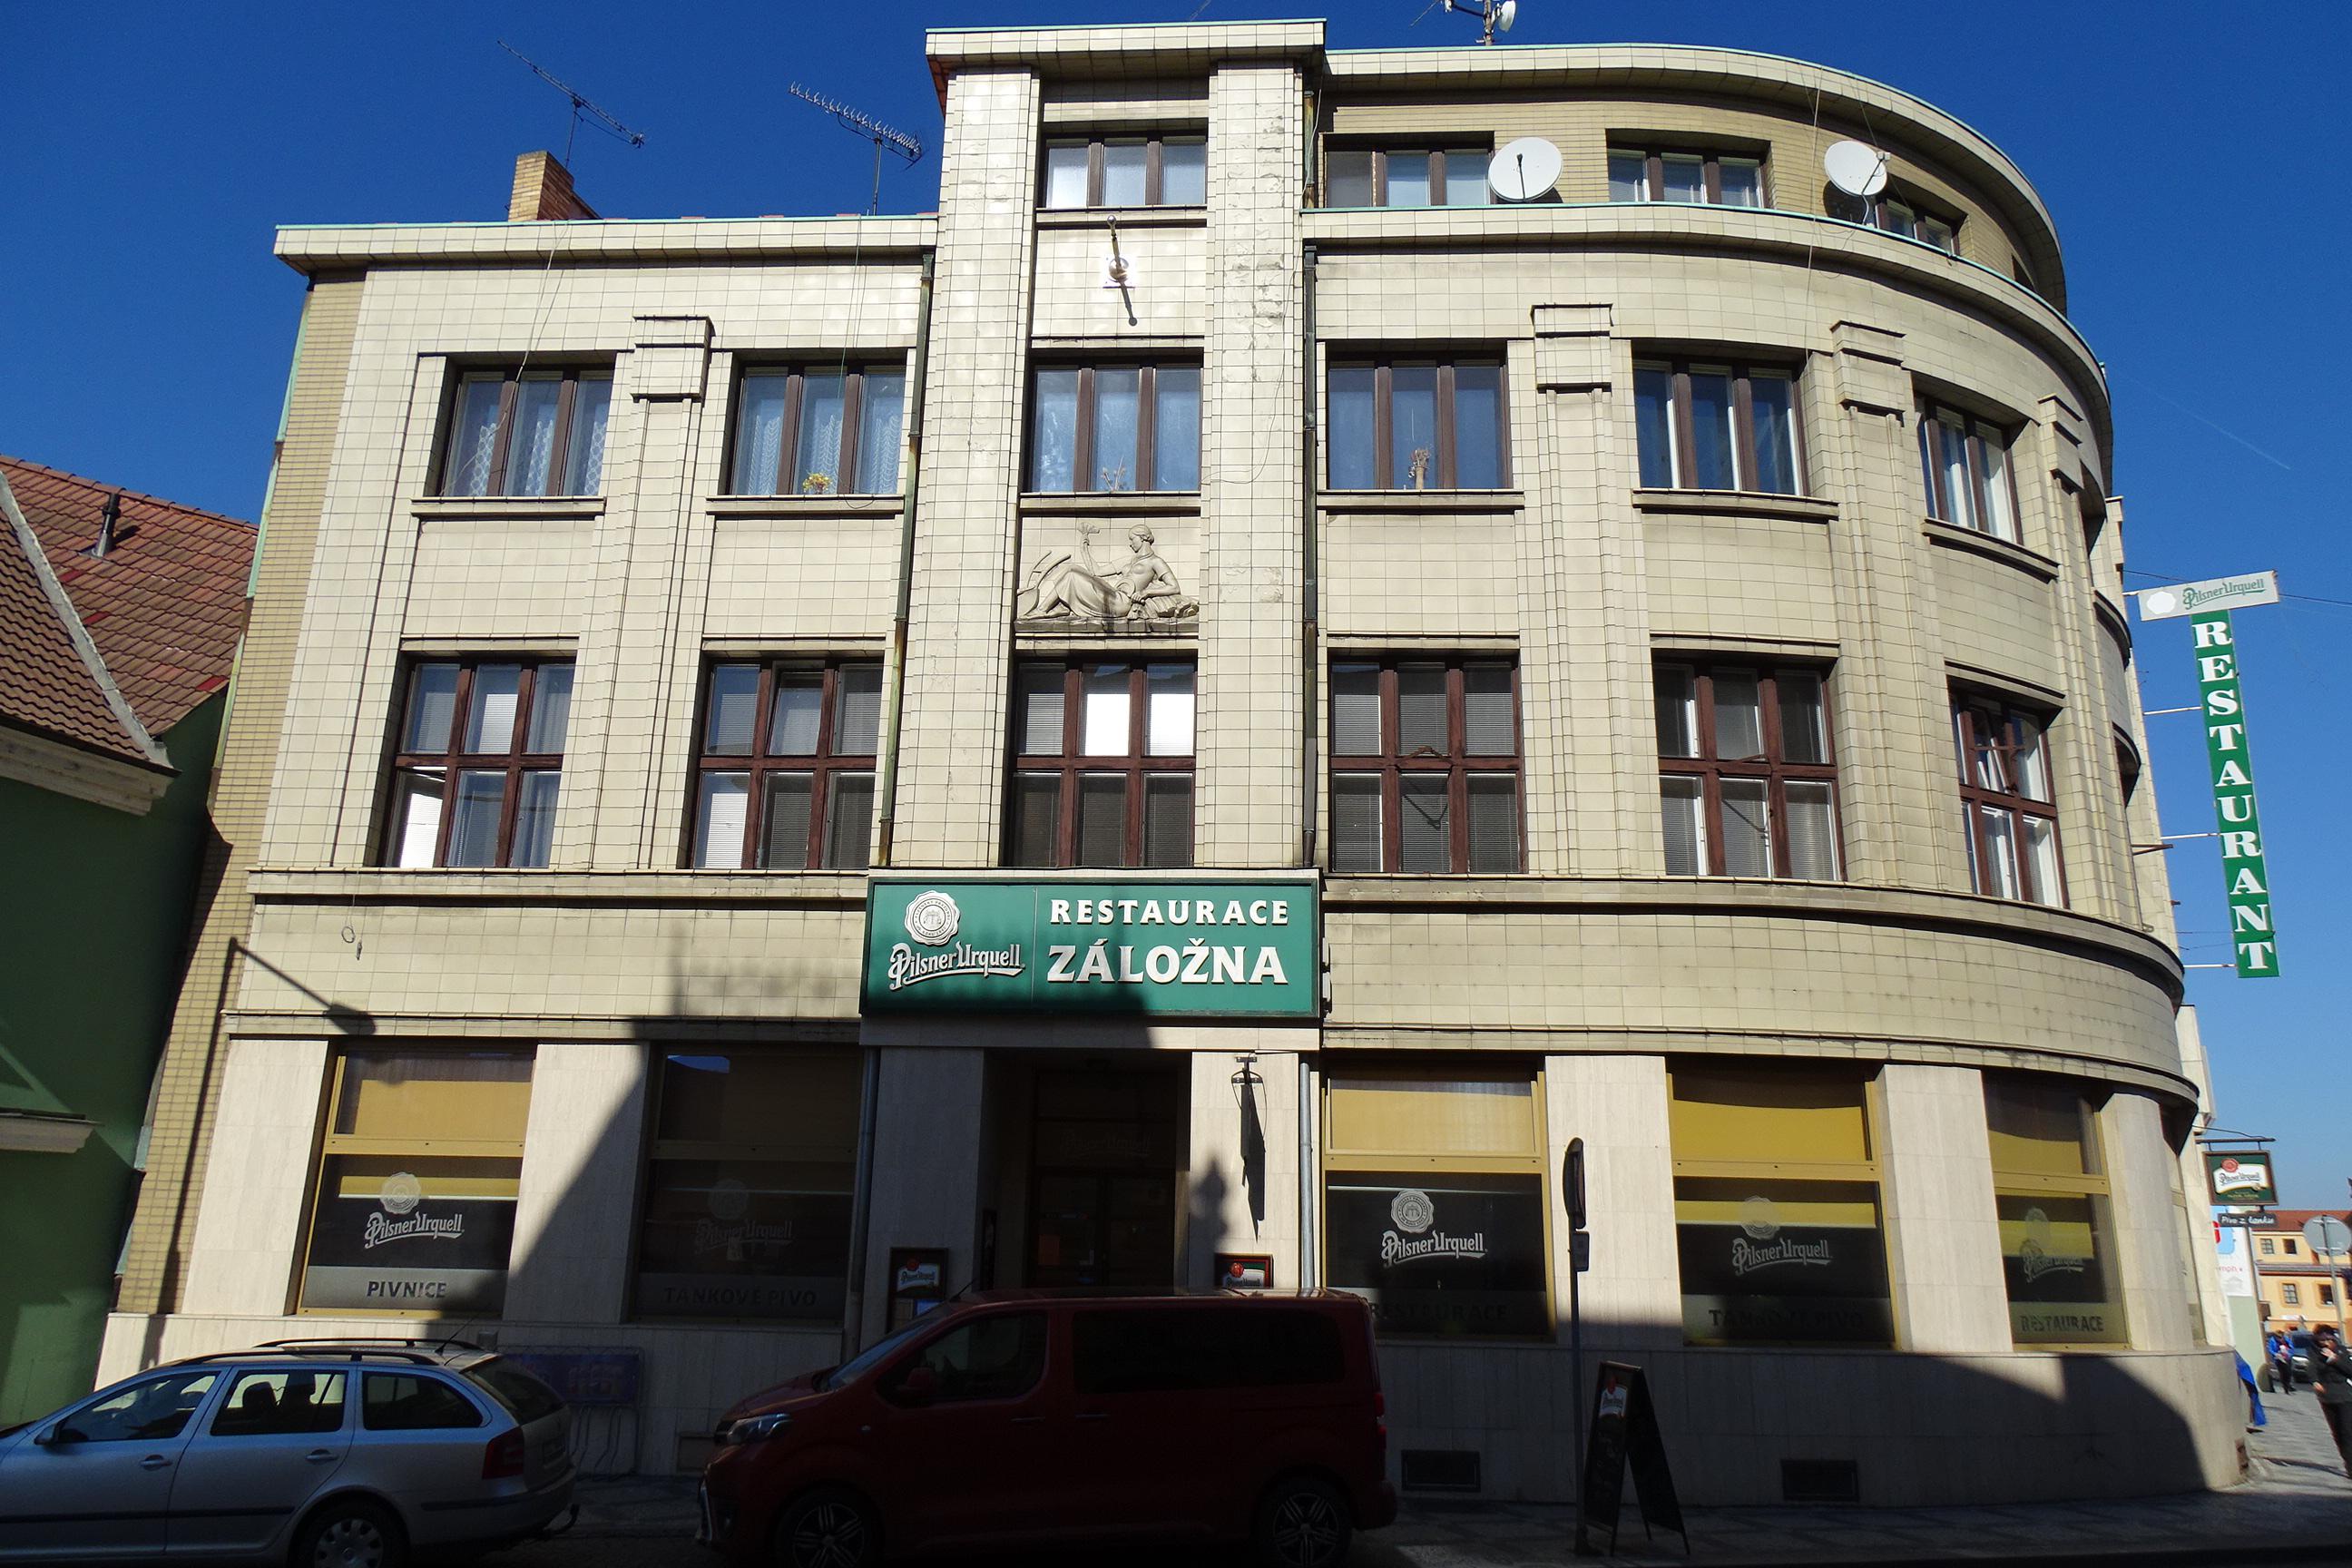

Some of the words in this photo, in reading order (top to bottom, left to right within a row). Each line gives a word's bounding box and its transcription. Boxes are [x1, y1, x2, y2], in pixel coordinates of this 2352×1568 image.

[2182, 587, 2224, 610] Pilsner
[2222, 579, 2264, 595] Urquell
[2191, 621, 2273, 970] RESTAURANT
[1050, 898, 1289, 925] RESTAURACE
[887, 942, 957, 990] Pilsner
[956, 940, 1021, 977] Urquell
[1046, 936, 1289, 985] ZÁLOŽNA
[364, 1212, 416, 1250] Pilsner
[415, 1211, 463, 1240] Urquell
[1381, 1230, 1434, 1269] Pilsner
[1432, 1229, 1485, 1259] Urquell
[1731, 1237, 1782, 1277] Pilsner
[1780, 1237, 1830, 1266] Urquell
[367, 1280, 448, 1298] PIVNICE
[768, 1289, 817, 1307] PIVO
[2020, 1315, 2104, 1332] RESTAURACE
